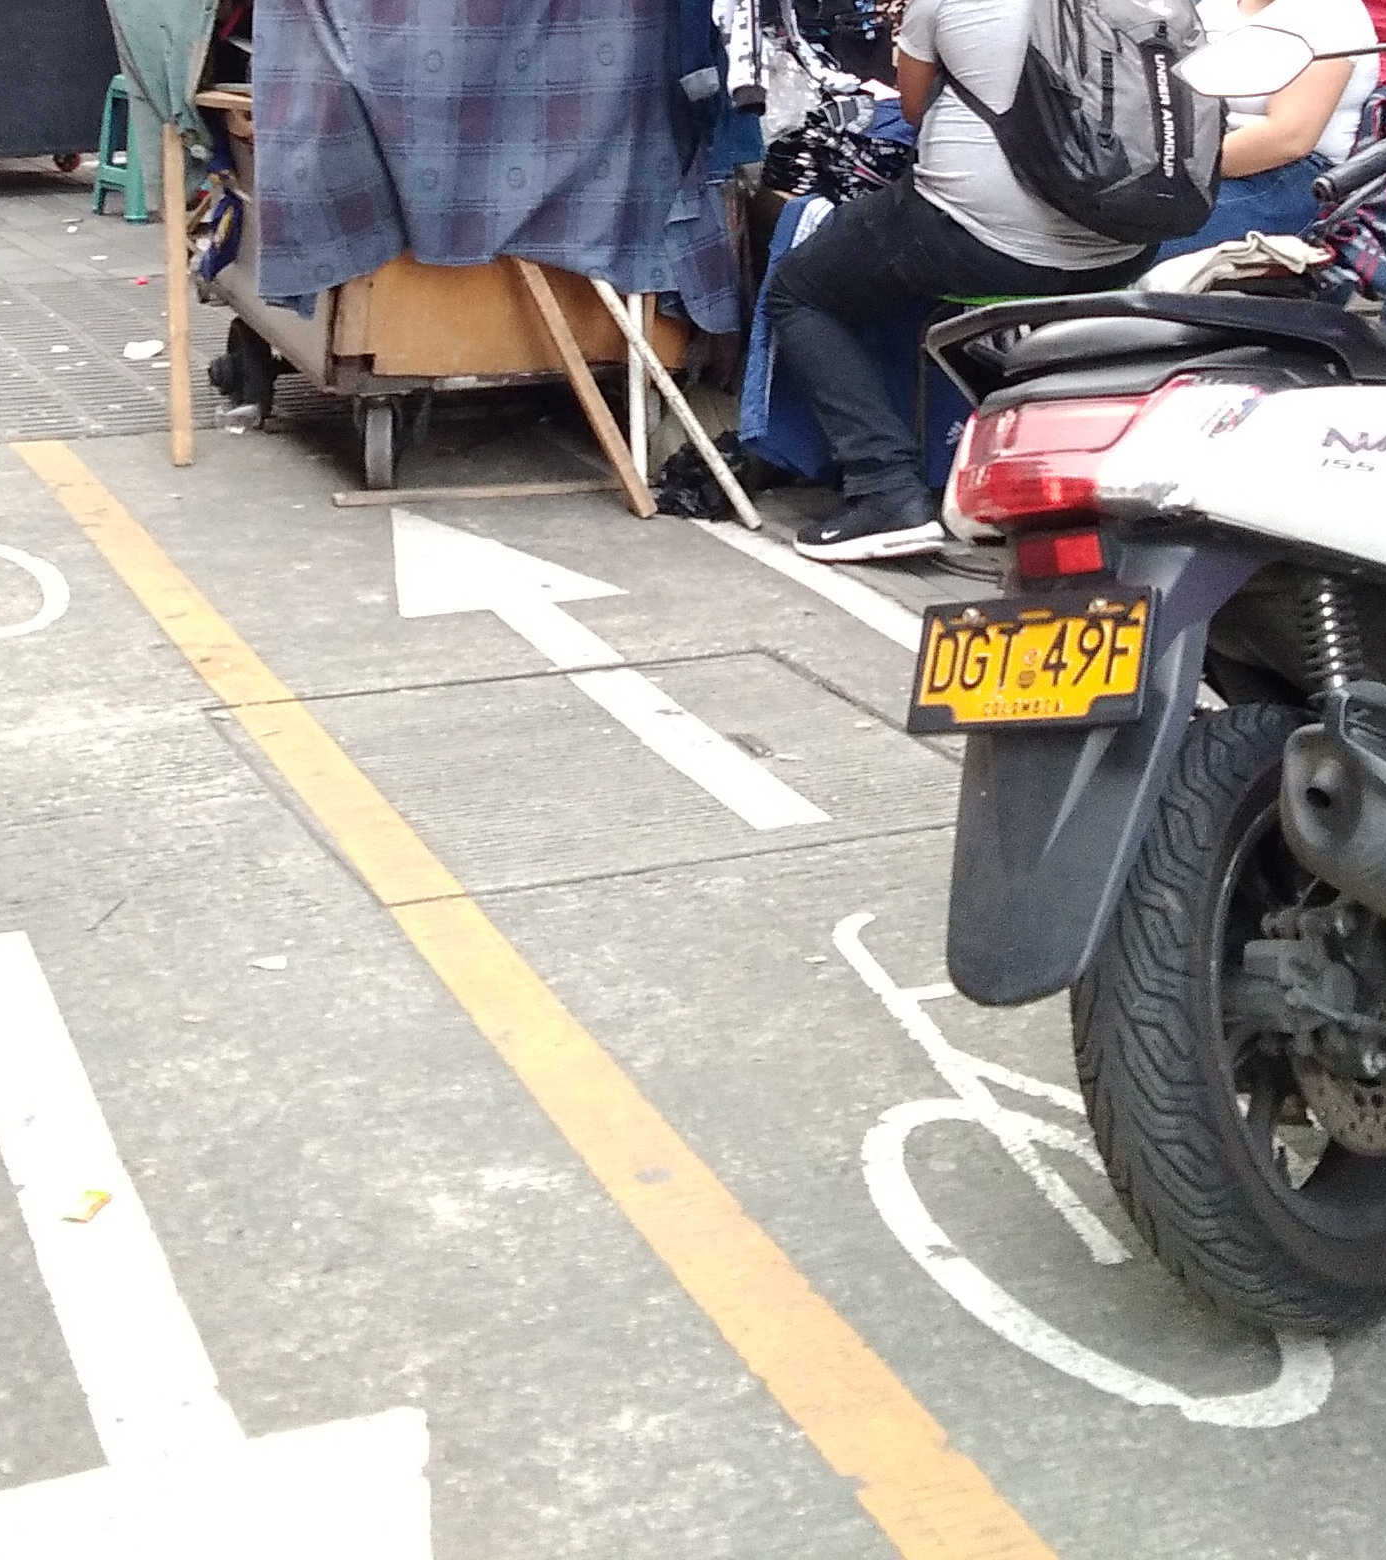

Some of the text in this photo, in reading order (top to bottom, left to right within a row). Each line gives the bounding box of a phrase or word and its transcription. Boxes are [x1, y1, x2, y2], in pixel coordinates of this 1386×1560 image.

[1154, 53, 1172, 106] UNDER
[927, 613, 1141, 693] DGT 49F
